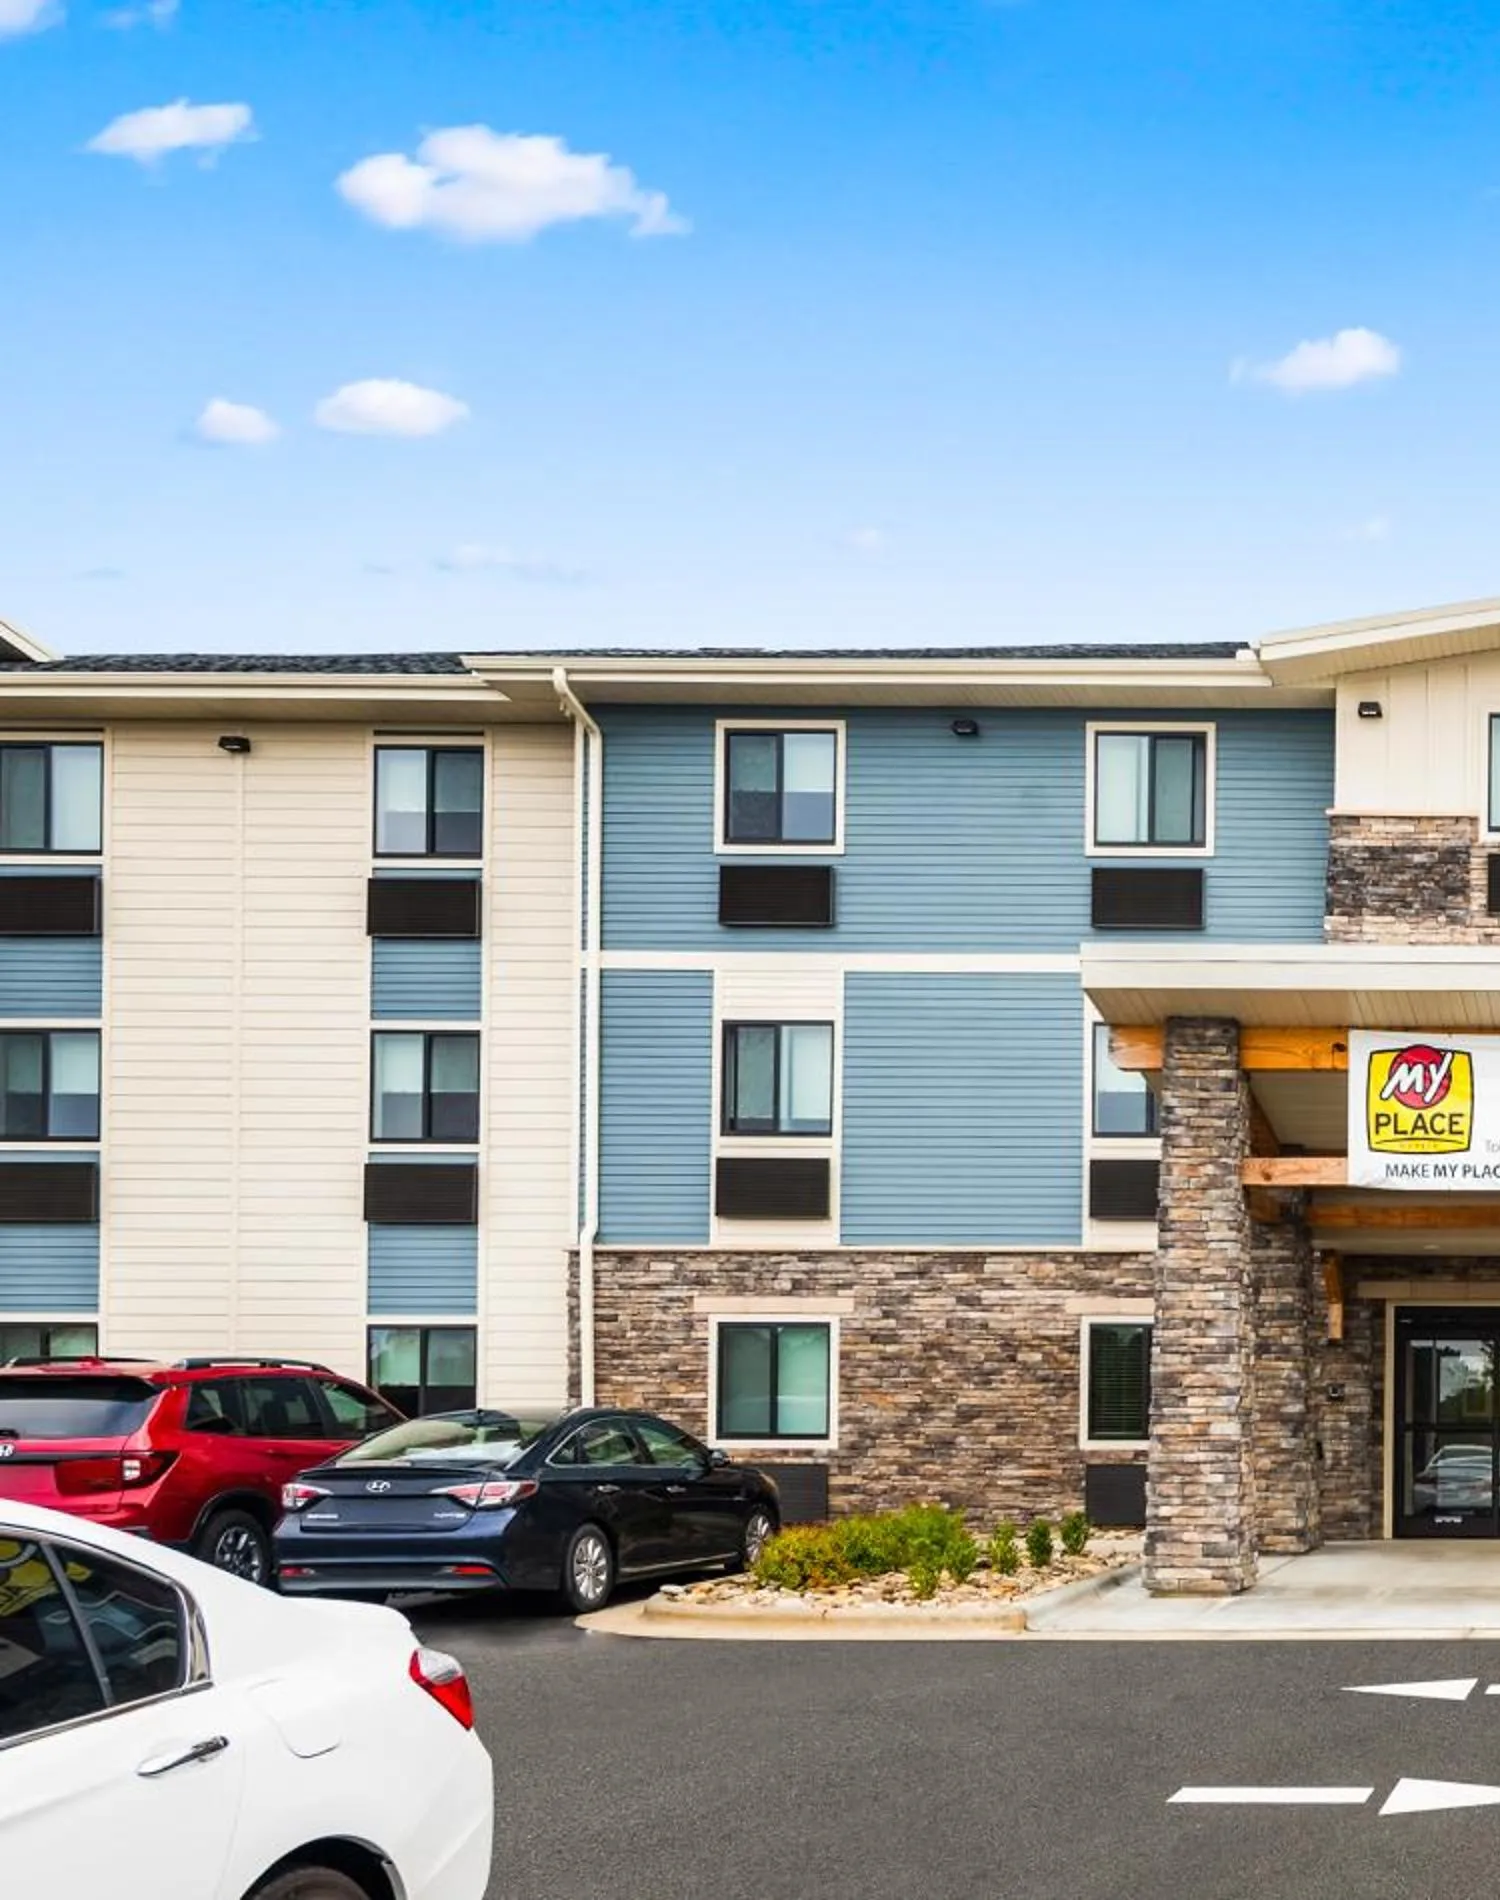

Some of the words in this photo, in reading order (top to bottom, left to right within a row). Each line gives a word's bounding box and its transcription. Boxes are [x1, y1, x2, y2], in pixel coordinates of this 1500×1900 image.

[1374, 1112, 1465, 1136] PLACE
[1385, 1163, 1430, 1178] MAKE
[1432, 1163, 1459, 1179] MY
